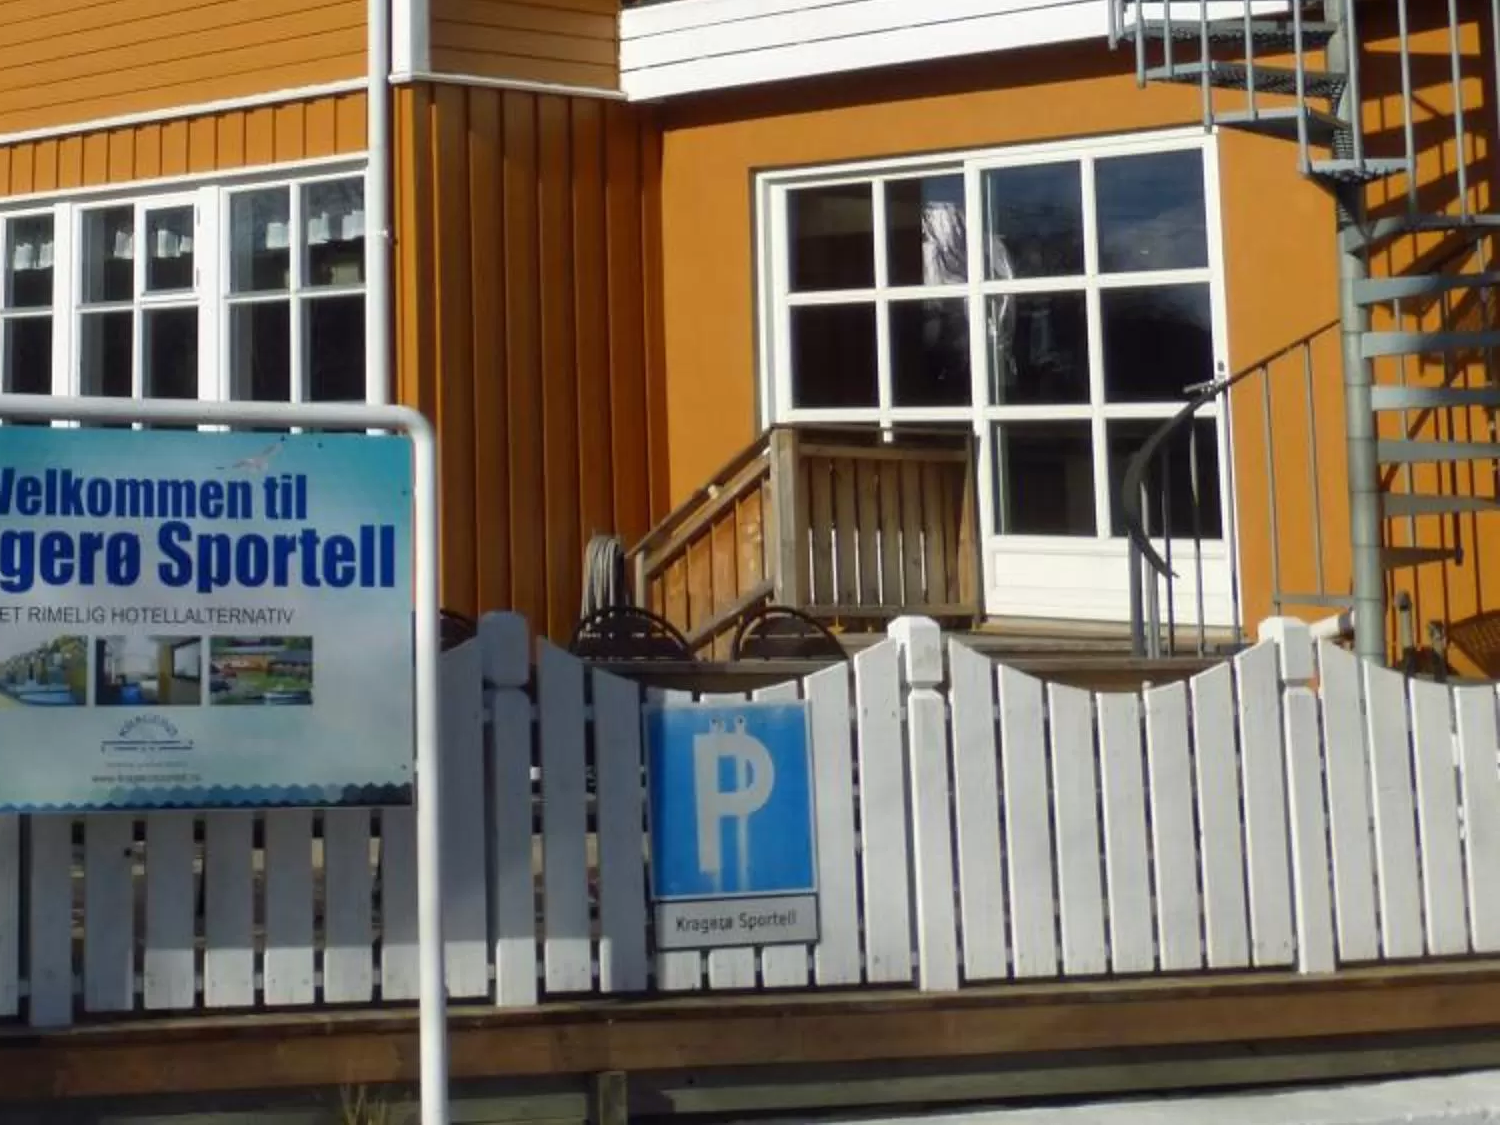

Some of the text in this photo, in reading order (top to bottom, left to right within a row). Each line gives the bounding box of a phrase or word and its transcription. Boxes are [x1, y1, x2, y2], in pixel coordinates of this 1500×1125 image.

[263, 472, 308, 521] til
[156, 520, 396, 595] Sportell
[0, 605, 294, 625] ET RIMELIG HOTELLALTERNATIV
[692, 733, 776, 874] P
[738, 909, 798, 932] Sportell
